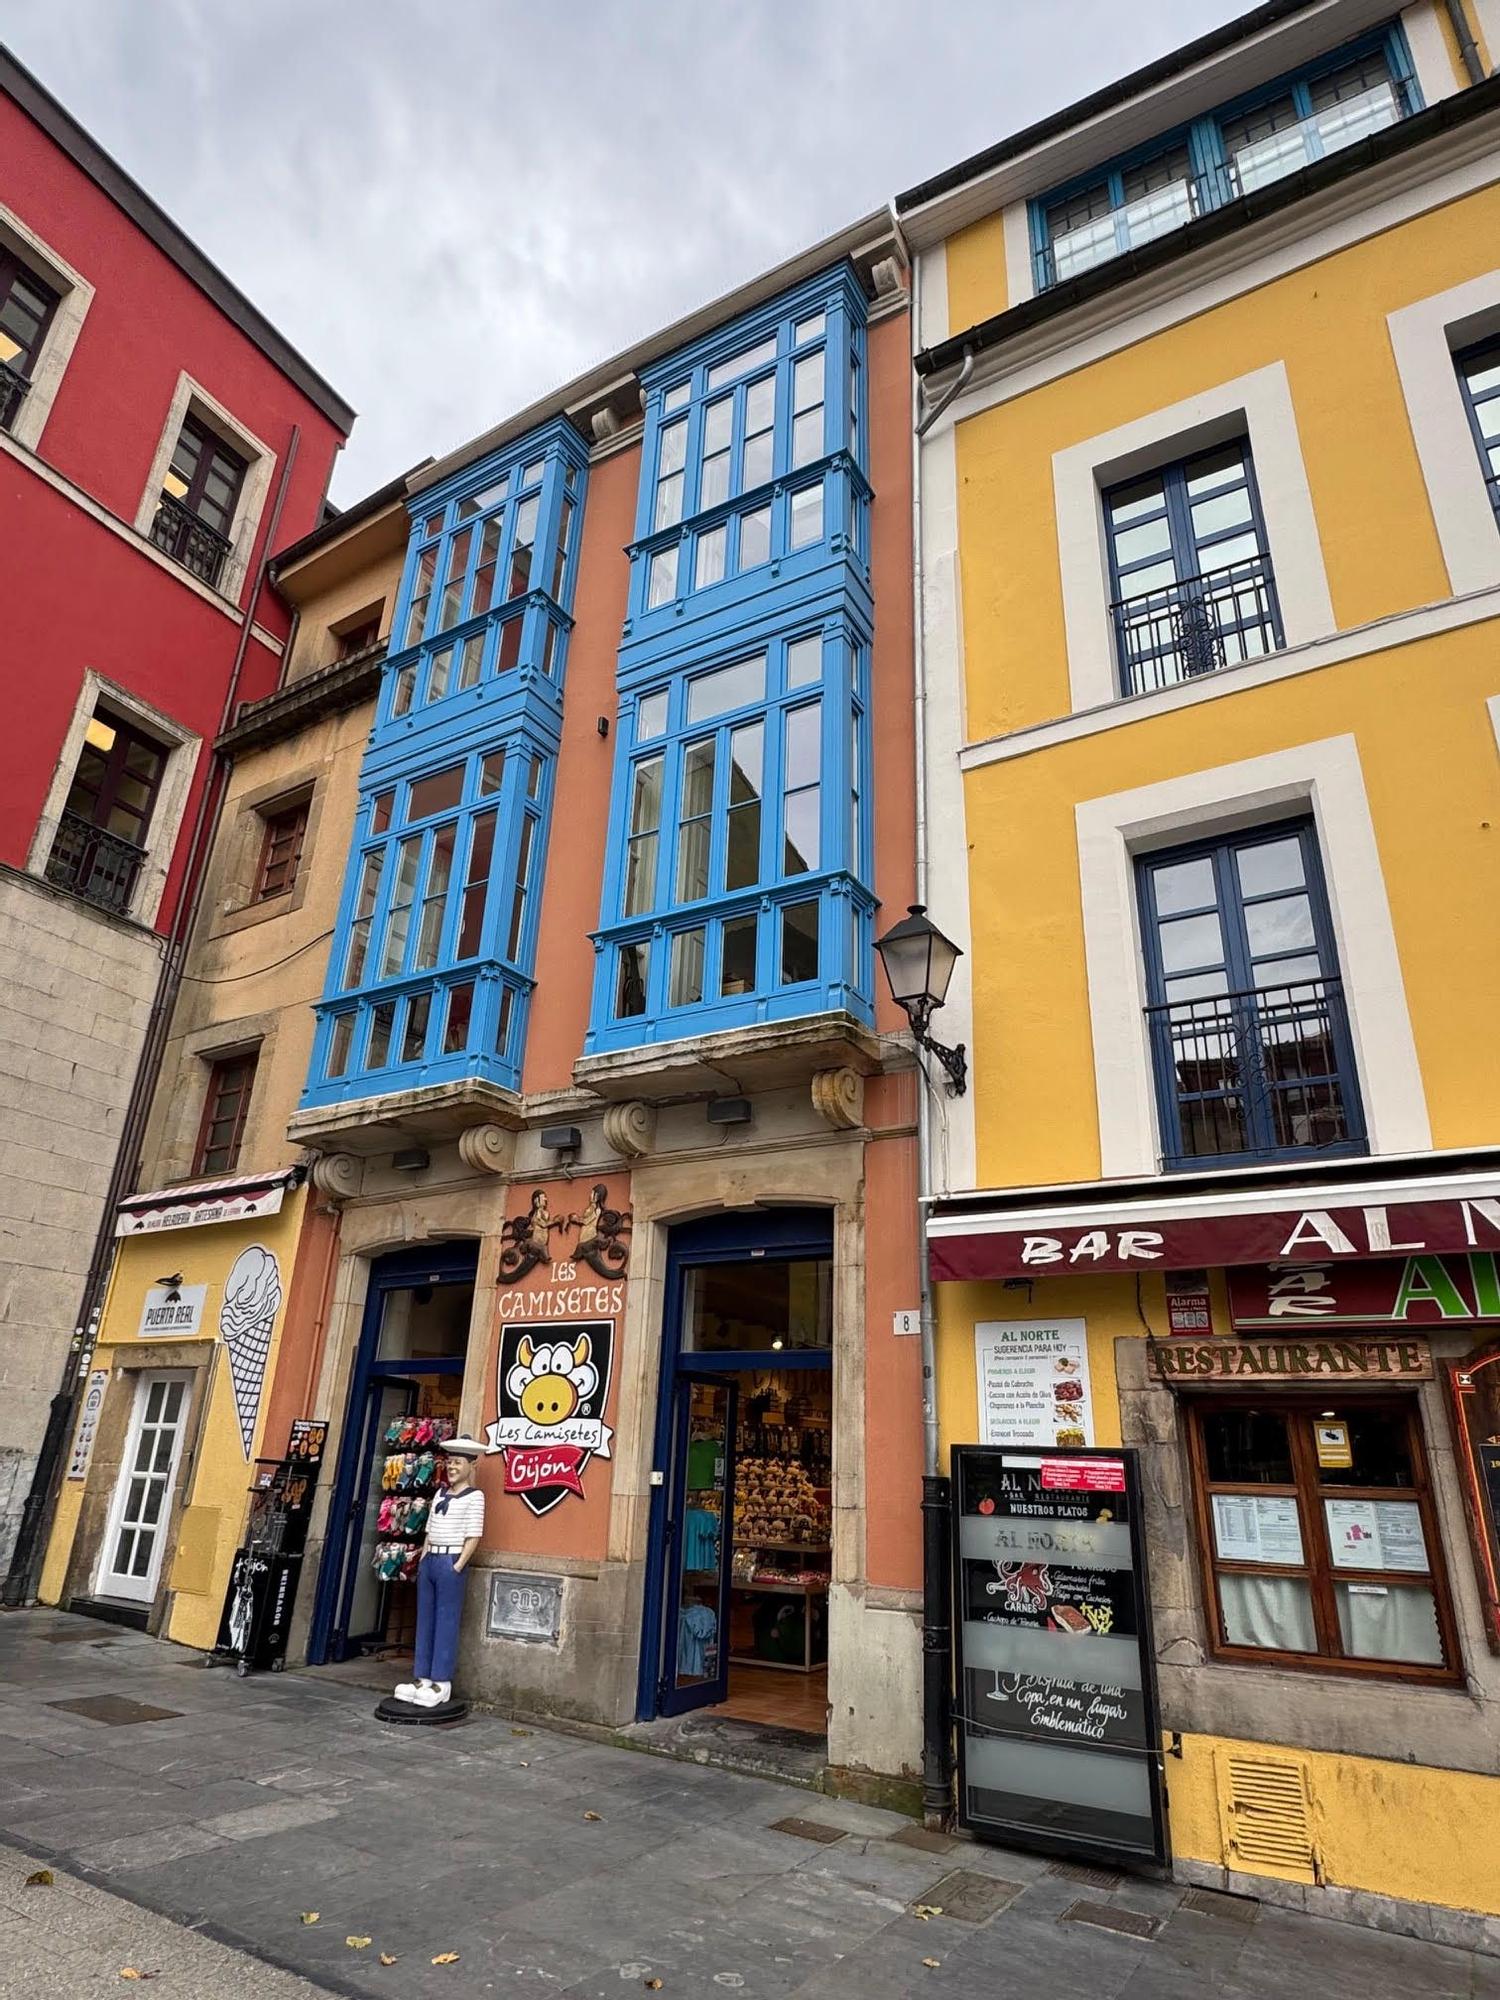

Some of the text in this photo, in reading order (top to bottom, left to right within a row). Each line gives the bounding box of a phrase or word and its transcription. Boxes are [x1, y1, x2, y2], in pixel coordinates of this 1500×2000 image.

[1280, 1207, 1425, 1255] AL
[1021, 1231, 1165, 1264] BAR
[551, 1261, 577, 1283] LES
[499, 1283, 624, 1318] CAMISETES
[1171, 1297, 1206, 1307] Alarma
[145, 1305, 195, 1326] PUERTA REAL
[903, 1315, 910, 1332] 8
[1001, 1330, 1060, 1342] AL NORTE
[1034, 1344, 1051, 1353] PARA
[1155, 1342, 1423, 1376] RESTAURANTE
[499, 1424, 598, 1443] Les Camisetes
[511, 1454, 571, 1487] Gijón
[1001, 1473, 1021, 1491] AL
[1010, 1503, 1088, 1517] NUESTROS PLATOS
[1004, 1602, 1038, 1614] CARNES
[1066, 1697, 1084, 1711] un
[1031, 1706, 1105, 1739] Emblemático
